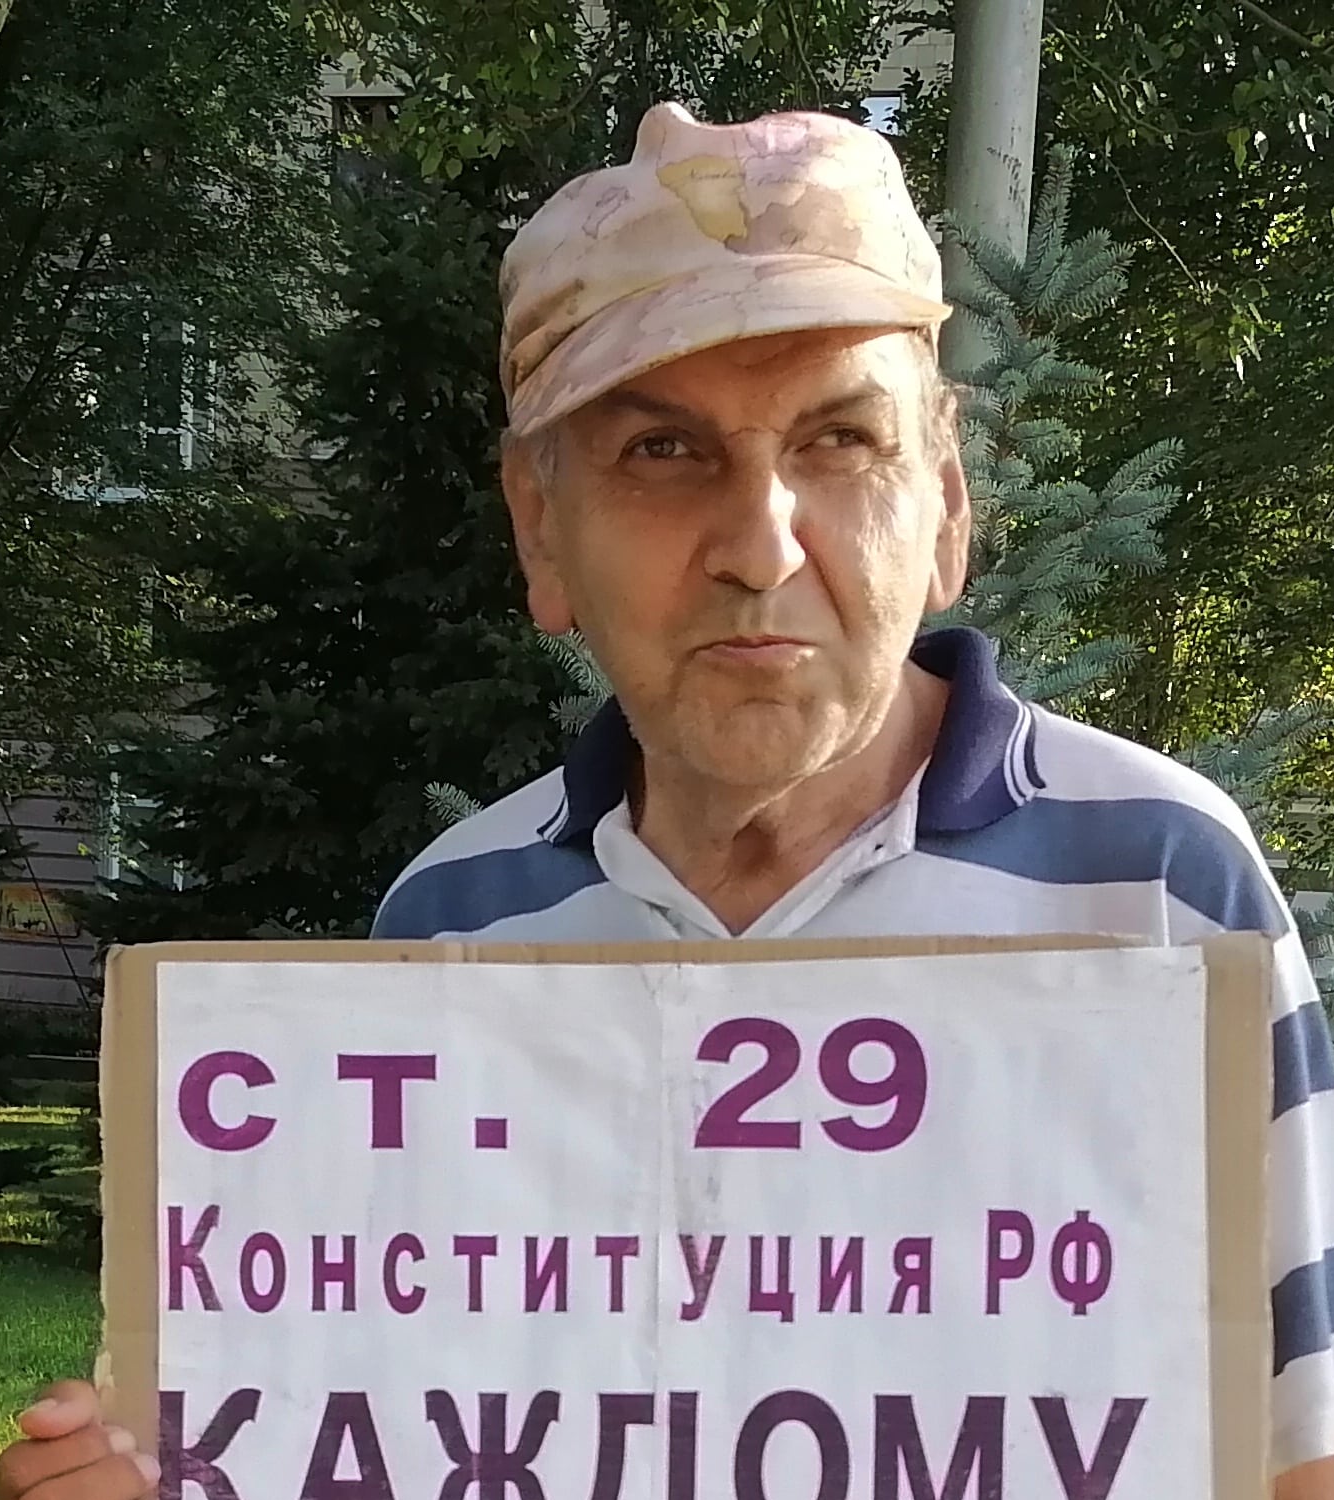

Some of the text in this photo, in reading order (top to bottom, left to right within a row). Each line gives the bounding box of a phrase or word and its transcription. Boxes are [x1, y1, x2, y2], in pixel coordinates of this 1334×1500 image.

[178, 1017, 928, 1152] ст. 29
[168, 1204, 1113, 1322] Конституция РФ
